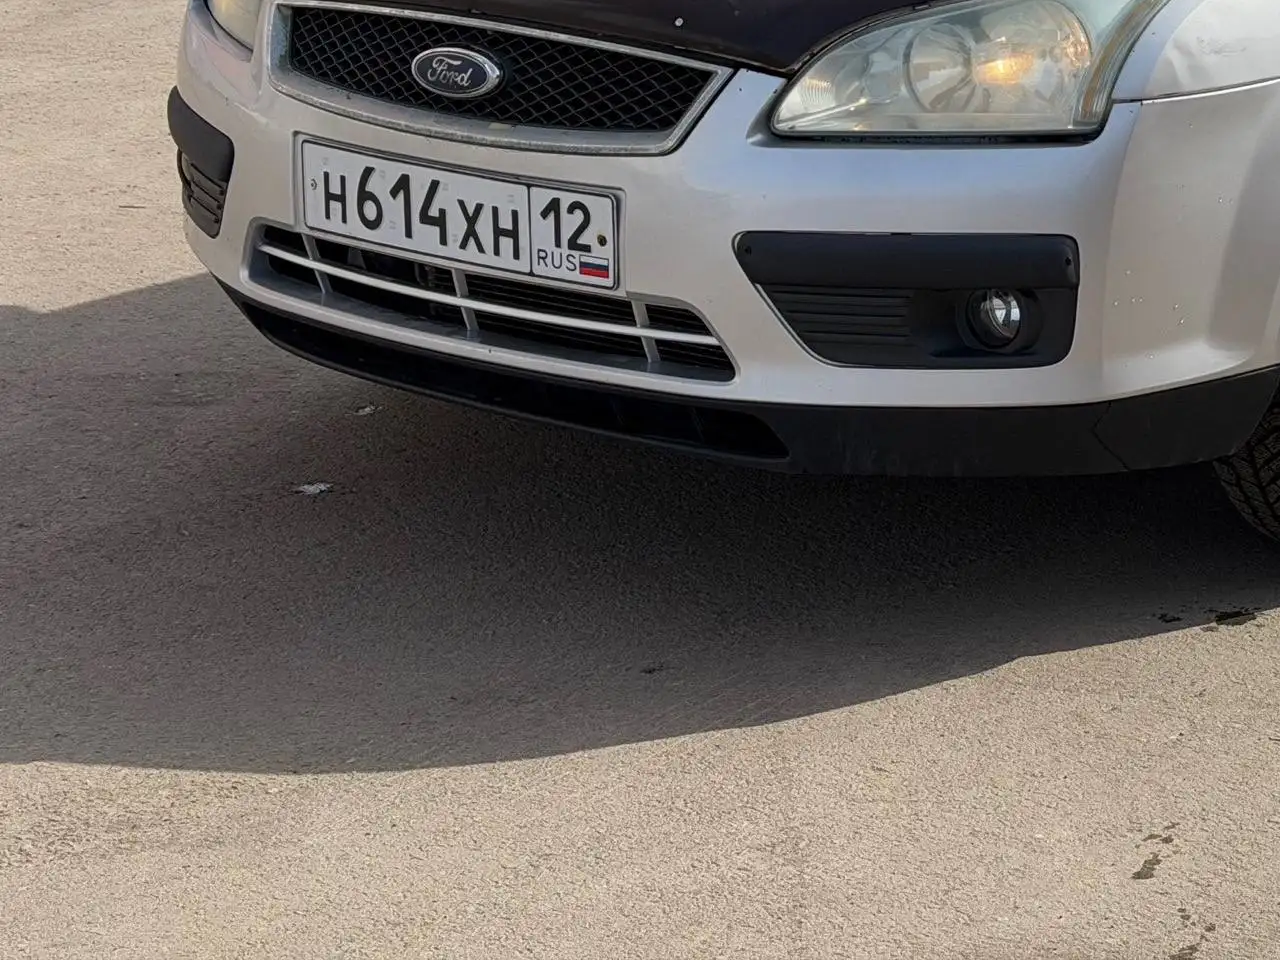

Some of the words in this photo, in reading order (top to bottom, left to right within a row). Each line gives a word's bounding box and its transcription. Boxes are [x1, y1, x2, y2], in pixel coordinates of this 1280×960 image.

[427, 56, 473, 87] Ford
[540, 197, 592, 253] 12
[537, 248, 577, 272] RUS
